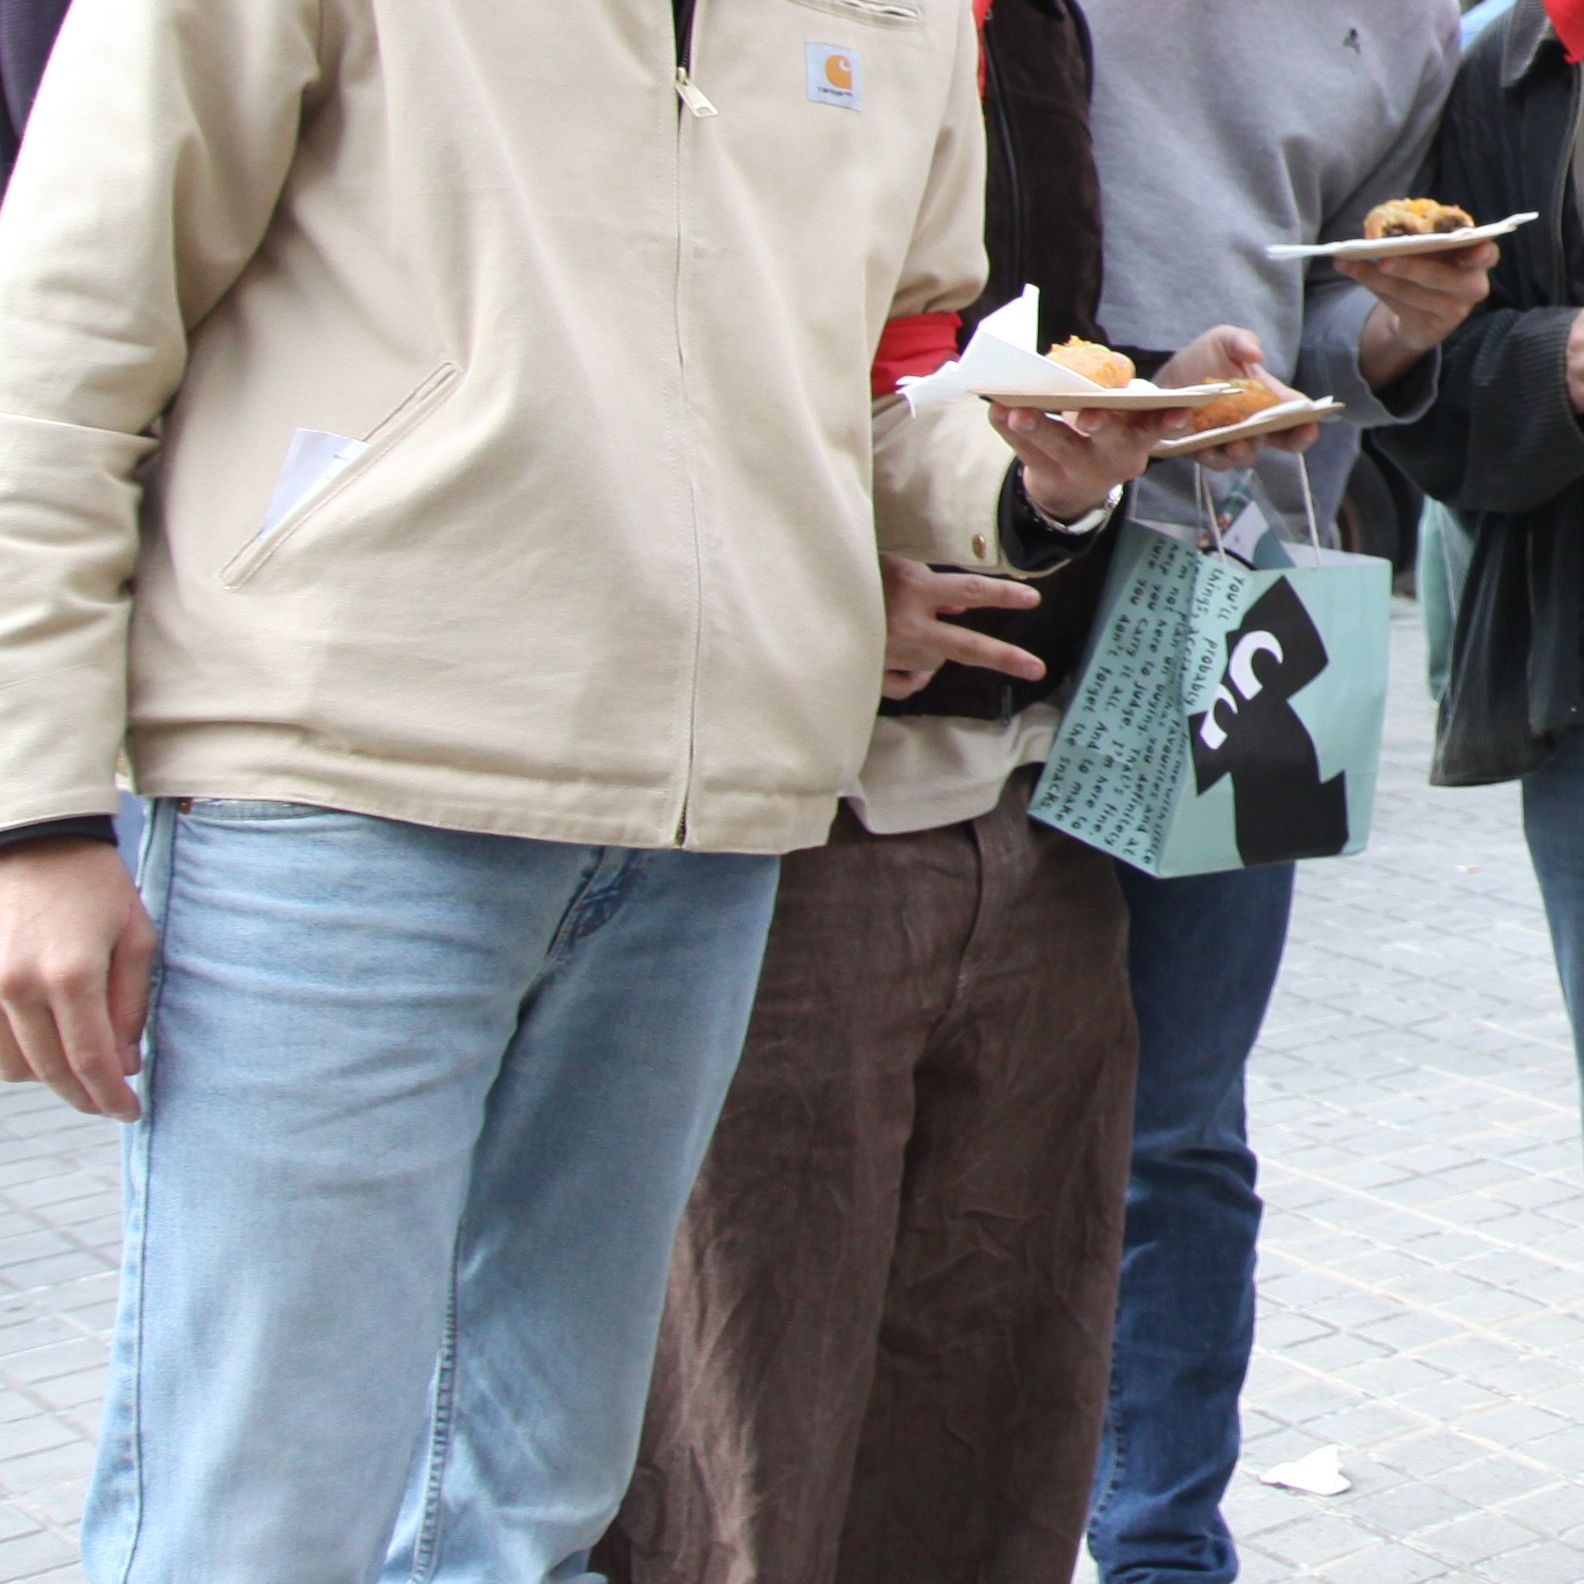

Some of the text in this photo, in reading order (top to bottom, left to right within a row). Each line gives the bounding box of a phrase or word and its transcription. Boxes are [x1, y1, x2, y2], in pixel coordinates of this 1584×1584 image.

[1177, 550, 1196, 579] I'm
[1130, 578, 1148, 605] you
[1147, 584, 1161, 611] you
[1164, 587, 1179, 612] not
[1188, 568, 1224, 619] things,
[1108, 614, 1130, 656] don't
[1125, 618, 1148, 658] carry
[1149, 619, 1167, 653] here
[1170, 611, 1189, 648] plan
[1120, 665, 1134, 678] it
[1140, 661, 1154, 676] to
[1161, 656, 1175, 676] on
[1179, 637, 1218, 707] probably
[1083, 666, 1113, 712] forget
[1121, 681, 1146, 728] judge.
[1064, 723, 1086, 747] the
[1086, 721, 1108, 750] And
[1100, 740, 1125, 769] I'm
[1143, 738, 1157, 764] you
[1078, 759, 1094, 774] to
[1056, 781, 1082, 821] make
[1086, 775, 1108, 808] here
[1070, 816, 1088, 829] to
[1104, 771, 1148, 846] definitely
[1136, 804, 1154, 833] and
[1123, 837, 1138, 855] at
